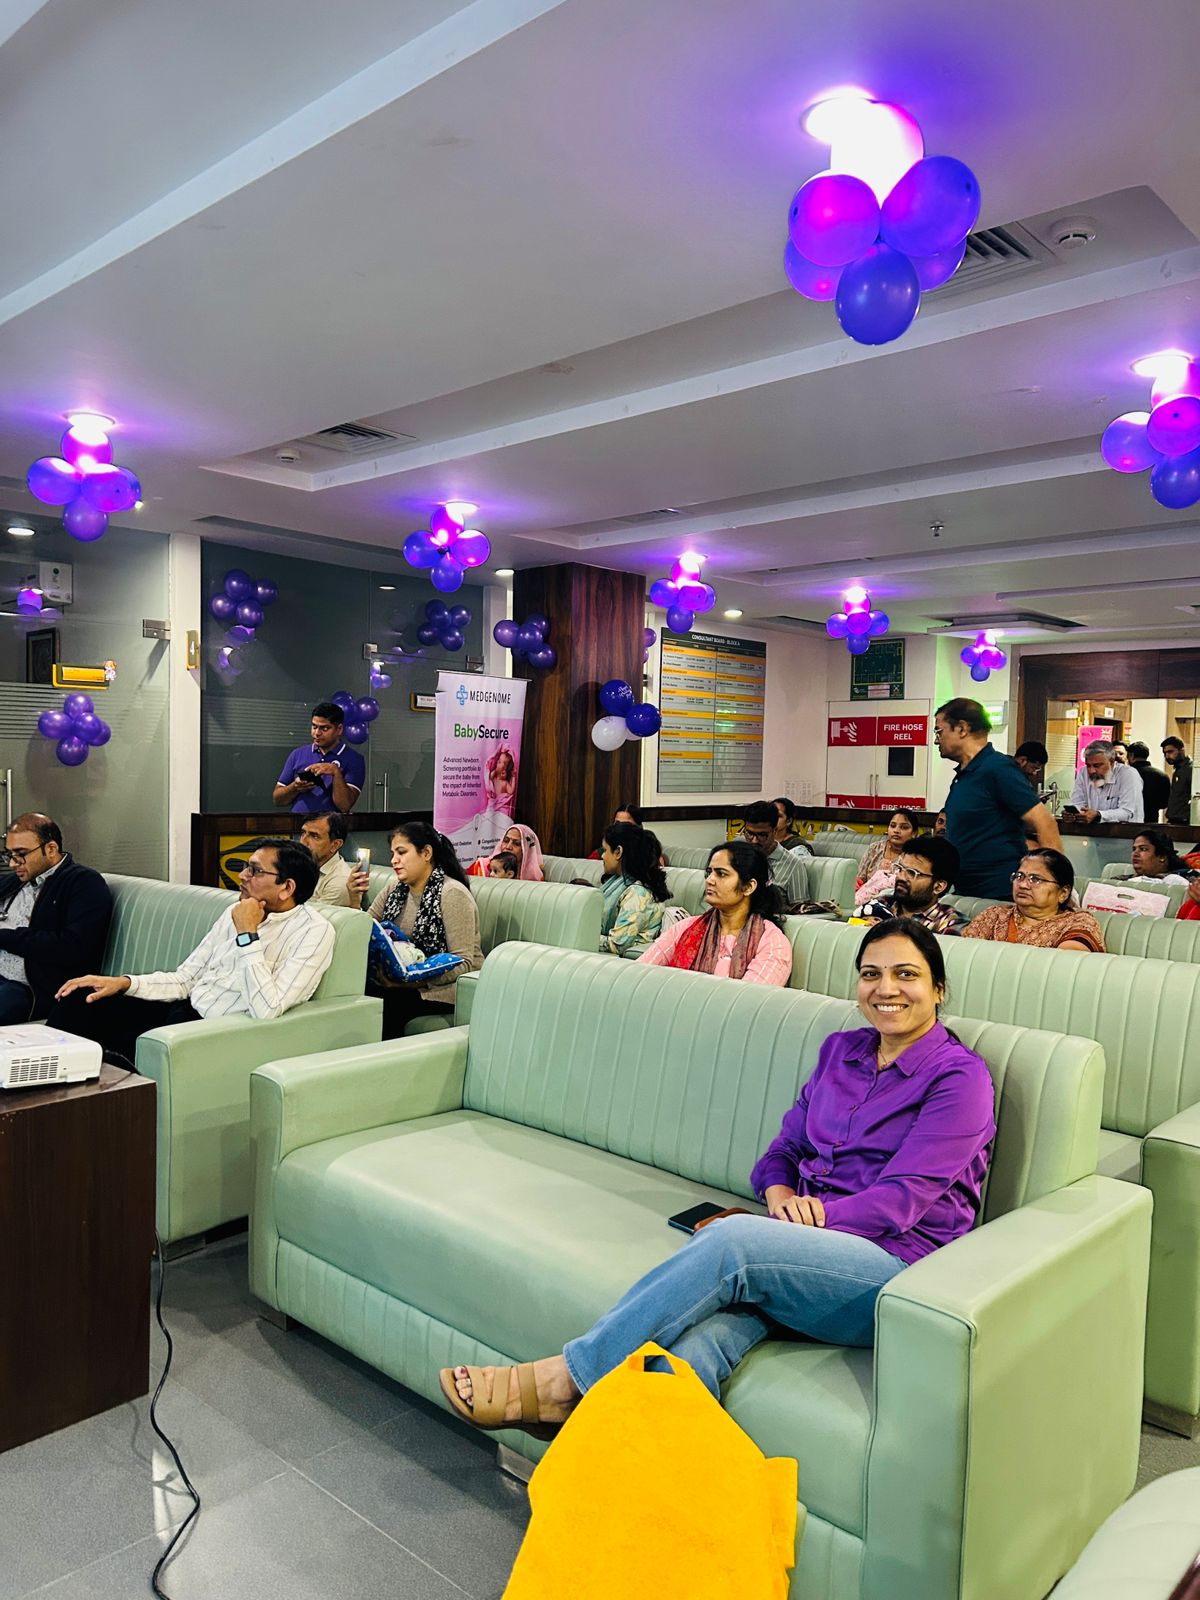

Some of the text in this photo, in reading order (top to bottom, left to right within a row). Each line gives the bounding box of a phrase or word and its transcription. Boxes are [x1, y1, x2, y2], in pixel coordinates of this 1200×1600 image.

[190, 640, 195, 655] 4
[470, 690, 511, 704] MEDGENOME
[454, 723, 509, 741] BabySecure
